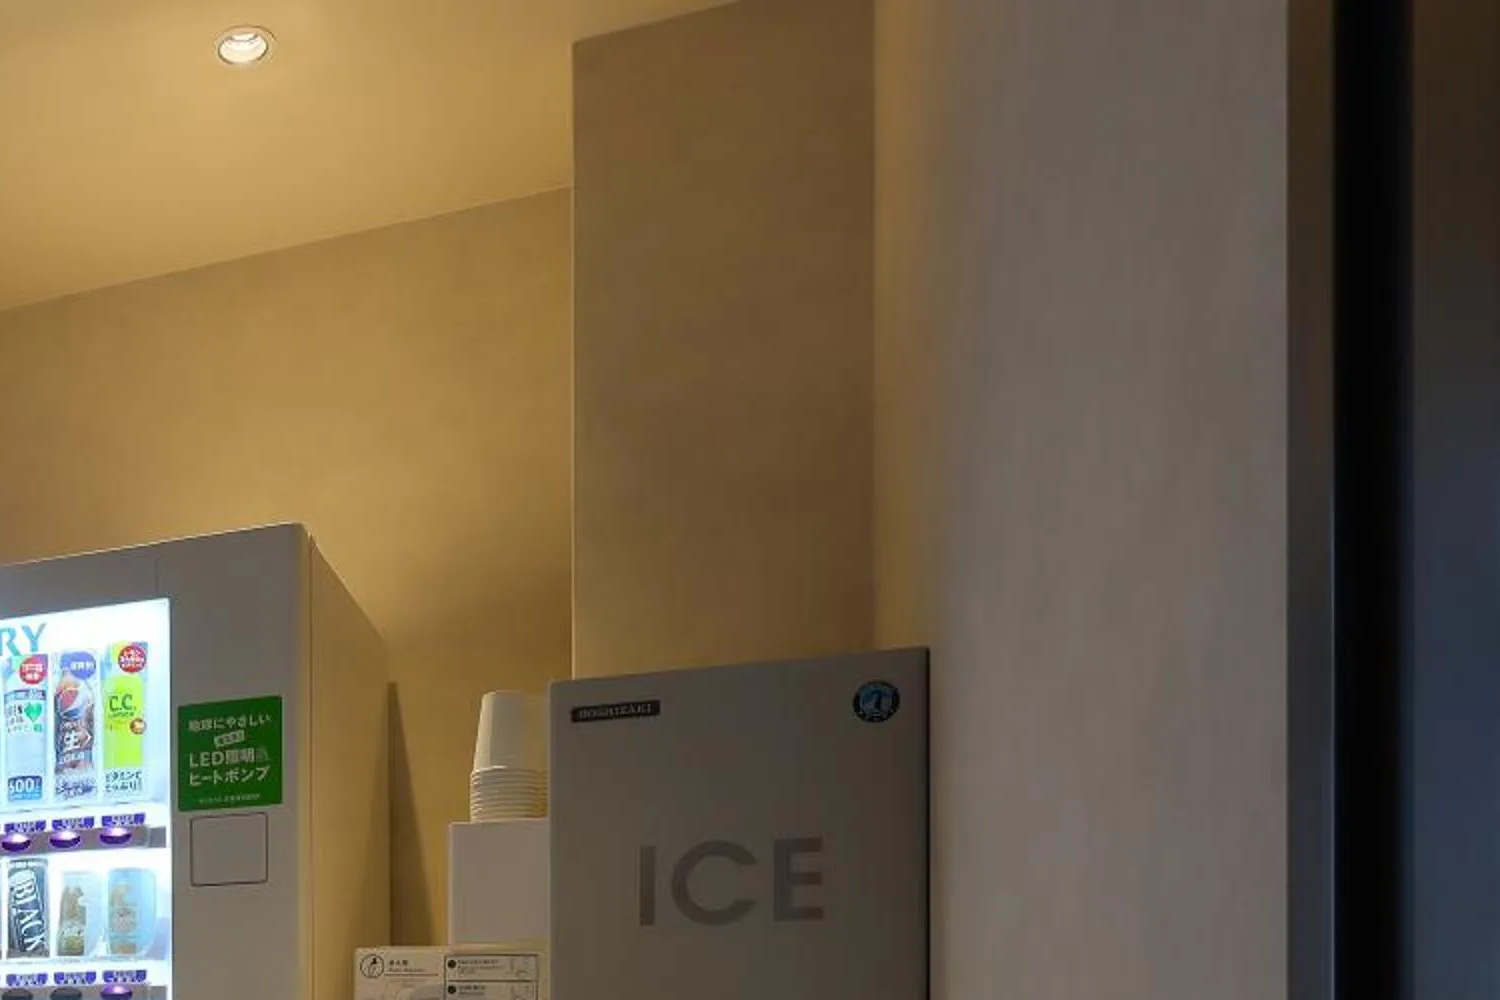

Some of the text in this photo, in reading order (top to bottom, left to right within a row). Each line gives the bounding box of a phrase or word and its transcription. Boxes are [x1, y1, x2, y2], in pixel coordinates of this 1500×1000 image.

[189, 765, 271, 787] ヒートポンプ
[13, 878, 45, 951] BLACK
[638, 836, 825, 927] ICE
